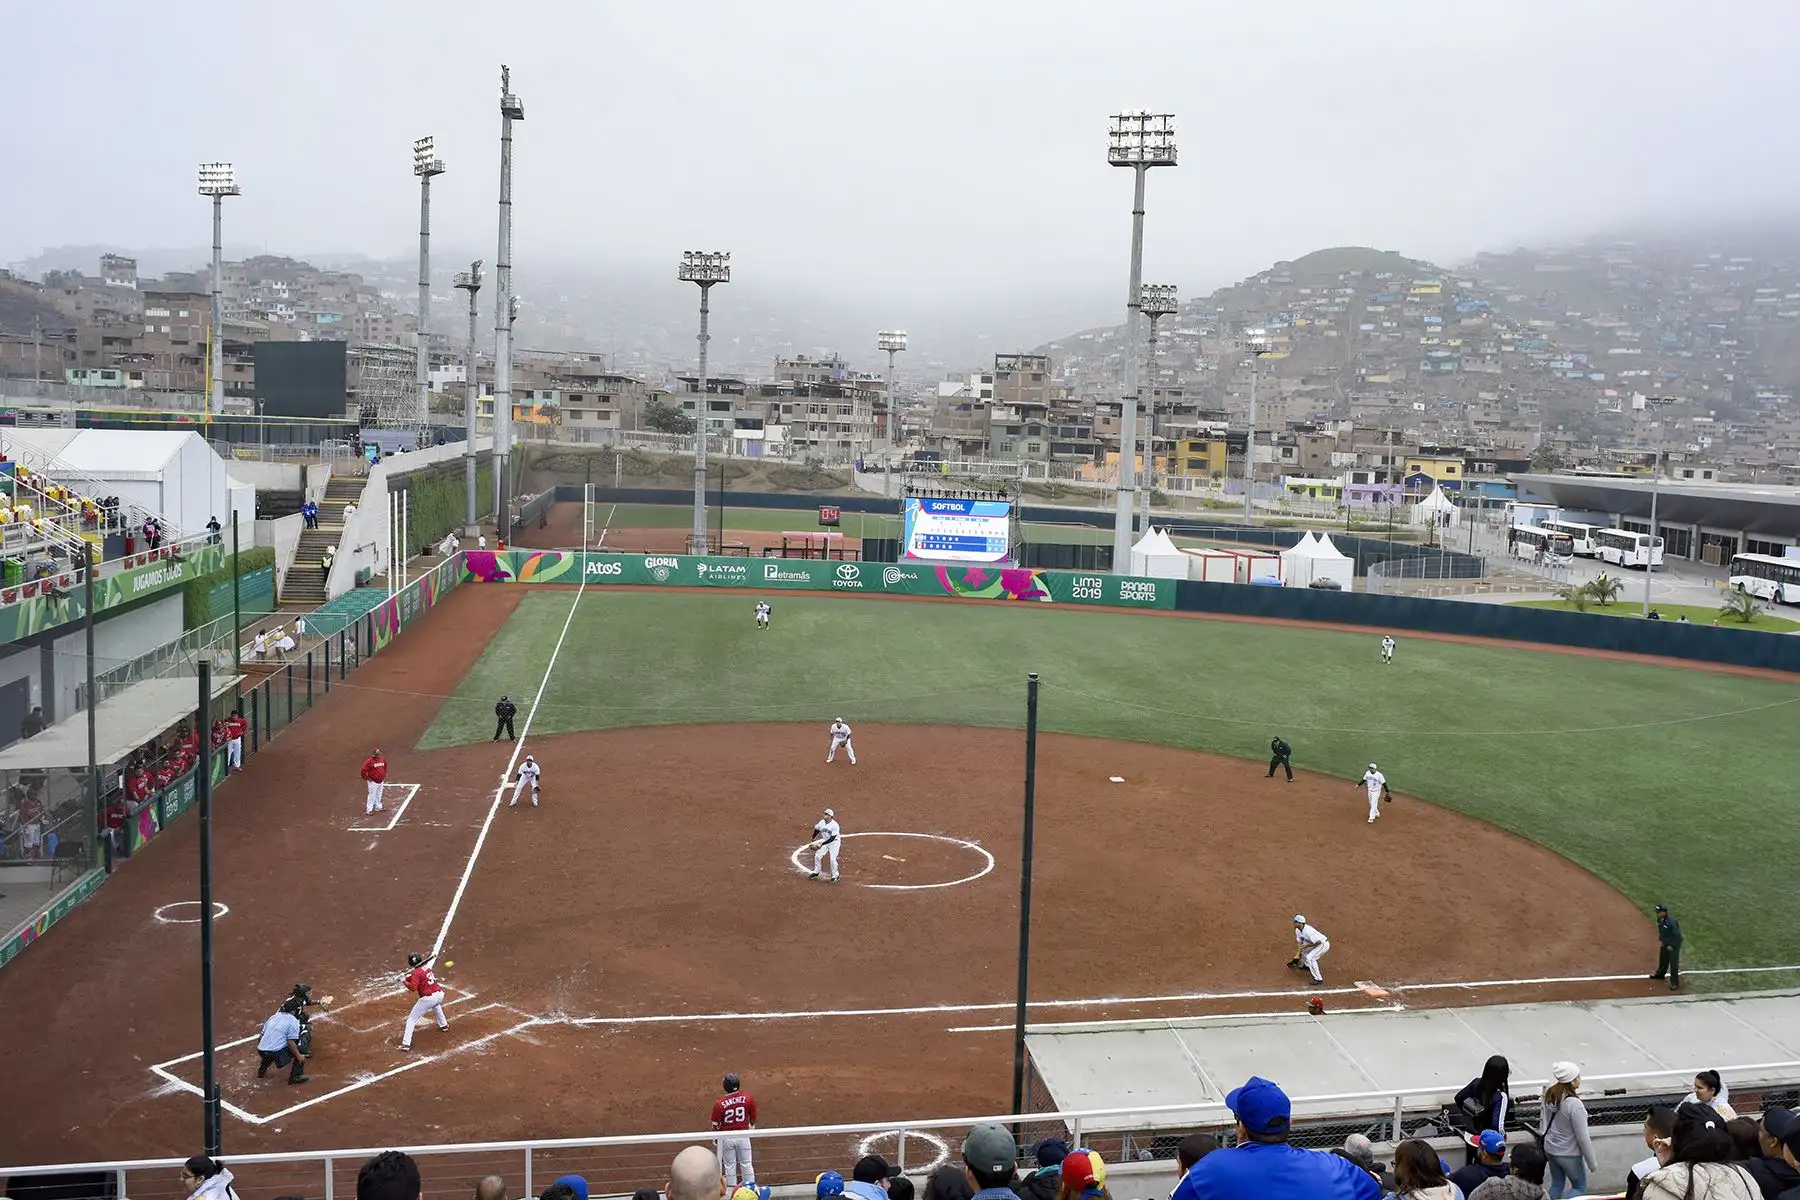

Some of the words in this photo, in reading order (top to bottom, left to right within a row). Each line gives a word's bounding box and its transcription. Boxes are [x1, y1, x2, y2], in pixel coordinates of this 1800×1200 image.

[932, 502, 966, 511] SOFTBOL
[822, 508, 838, 520] 04
[644, 557, 679, 570] GLORIA
[709, 565, 746, 573] LATAM
[133, 570, 162, 592] JUGAMOS
[832, 580, 863, 588] TOYOTA
[1072, 587, 1102, 599] 2019
[1120, 590, 1156, 602] SPORTS
[721, 1096, 746, 1109] SANCHEZ
[724, 1106, 745, 1123] 29
